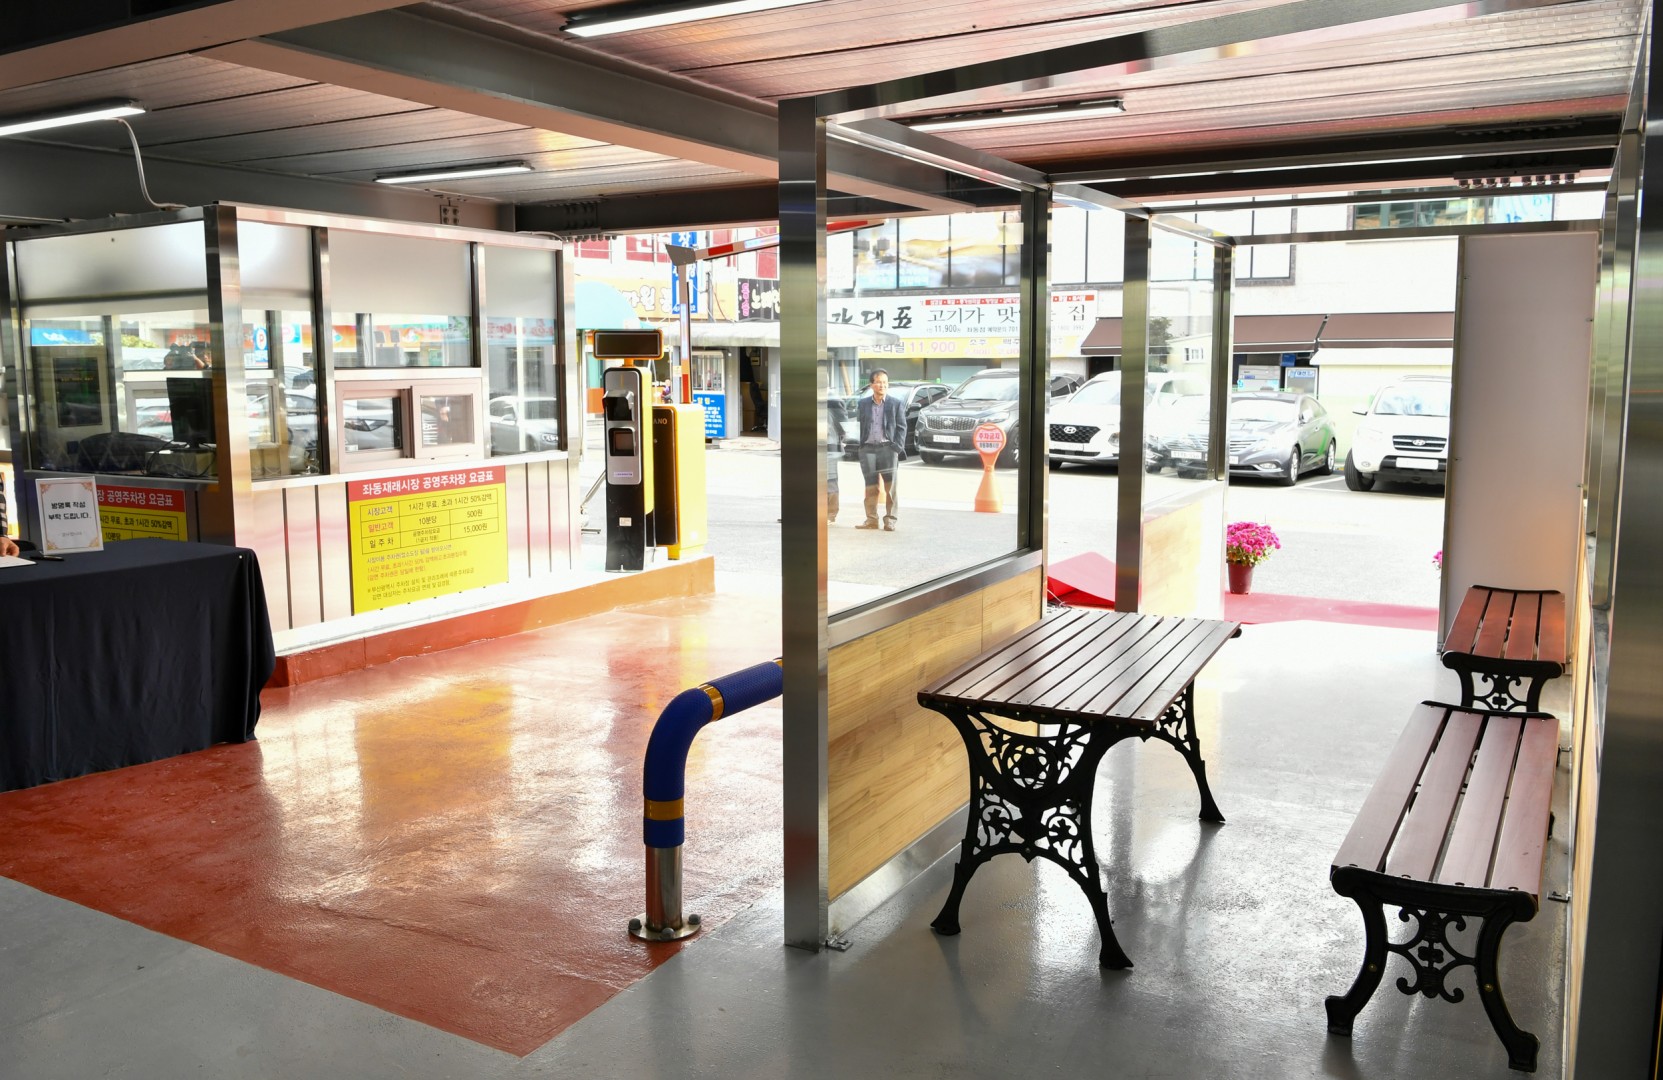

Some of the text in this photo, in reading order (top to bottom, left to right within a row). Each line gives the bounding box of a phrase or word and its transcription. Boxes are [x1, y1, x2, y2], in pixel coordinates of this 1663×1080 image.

[927, 306, 984, 324] 고기가
[1068, 304, 1085, 322] 집
[362, 470, 494, 496] 좌동재래시장 공영주차장 요금표
[107, 490, 146, 505] 공영주차장
[149, 494, 173, 506] 요금표
[408, 502, 424, 510] 1시간
[442, 498, 452, 506] 초과
[454, 496, 468, 504] 1시간
[368, 505, 393, 516] 시장고객
[467, 509, 482, 518] 500원
[124, 516, 134, 526] 초과
[136, 519, 149, 527] 1시간
[419, 516, 437, 525] 10분당
[368, 522, 394, 533] 일반고객
[463, 523, 488, 533] 15,000원
